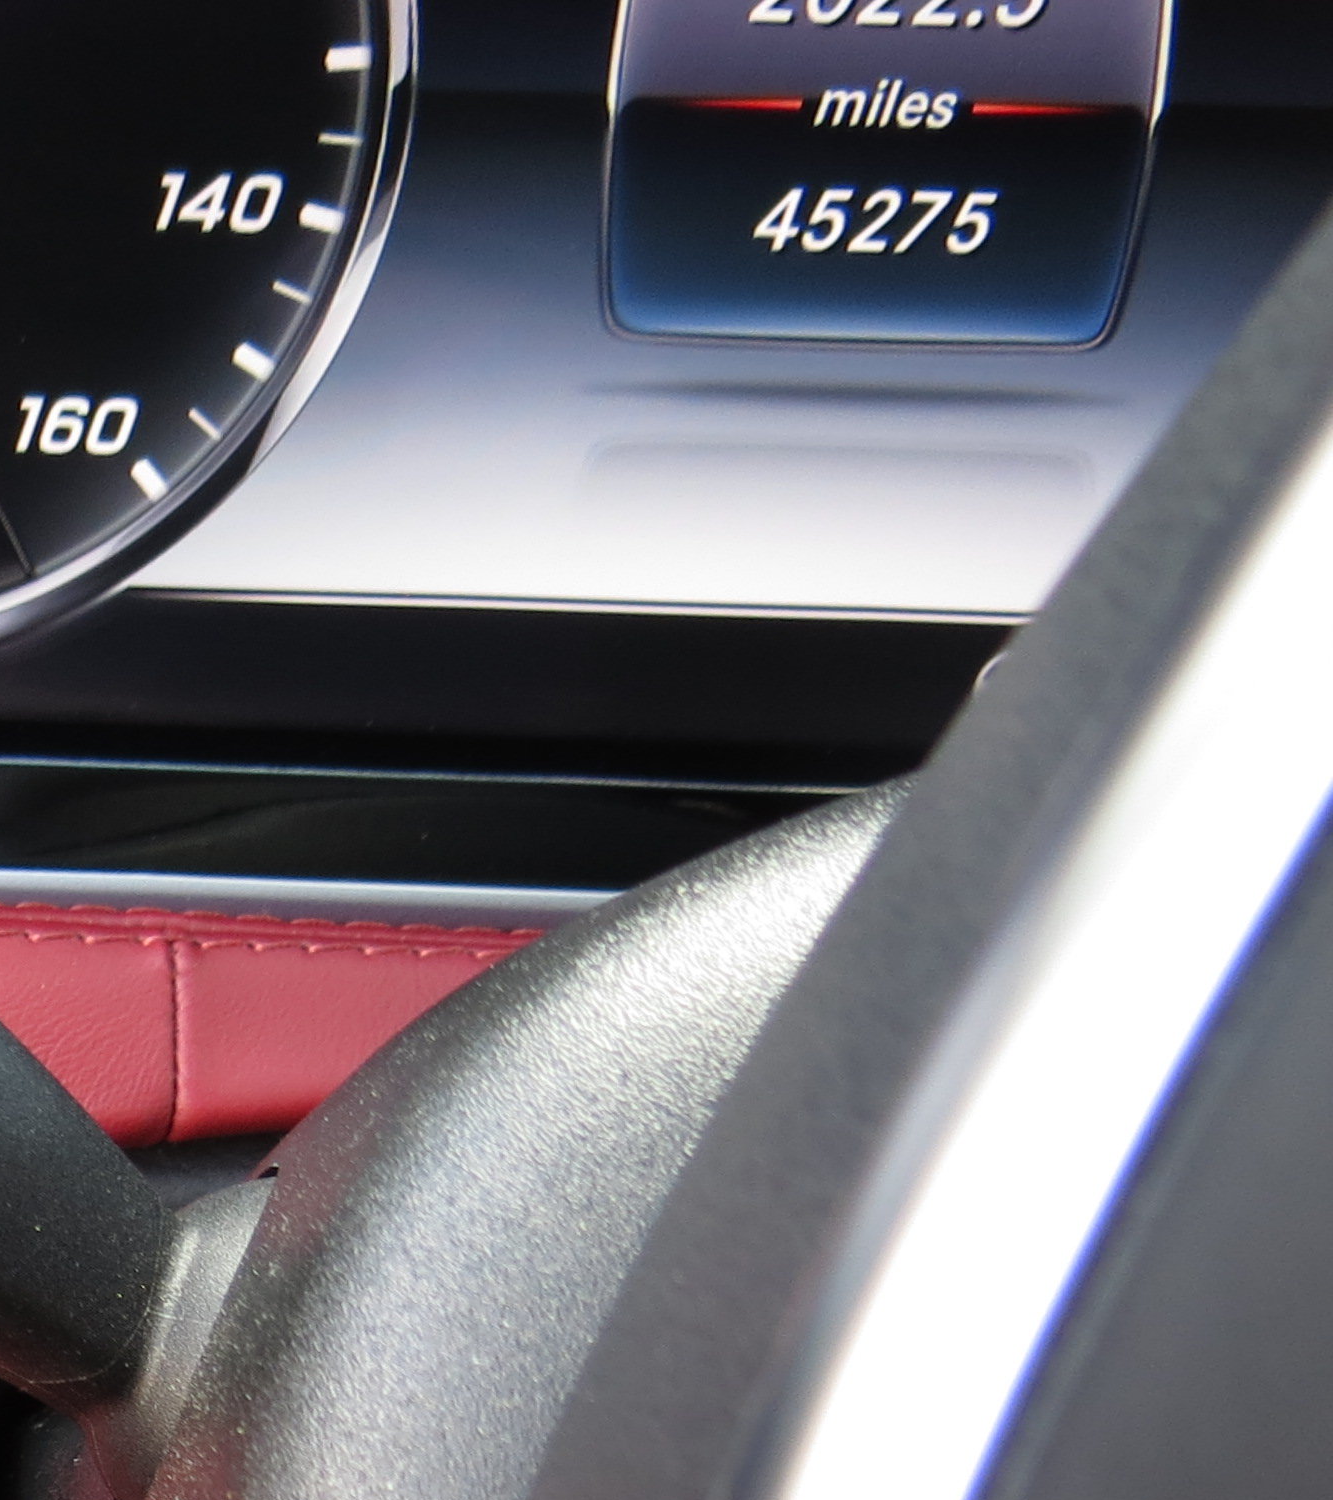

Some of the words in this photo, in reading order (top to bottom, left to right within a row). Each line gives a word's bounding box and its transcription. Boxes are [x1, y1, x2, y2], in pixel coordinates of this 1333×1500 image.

[813, 79, 958, 129] miles
[156, 173, 282, 234] 140
[753, 188, 998, 254] 45275
[16, 396, 138, 458] 160
